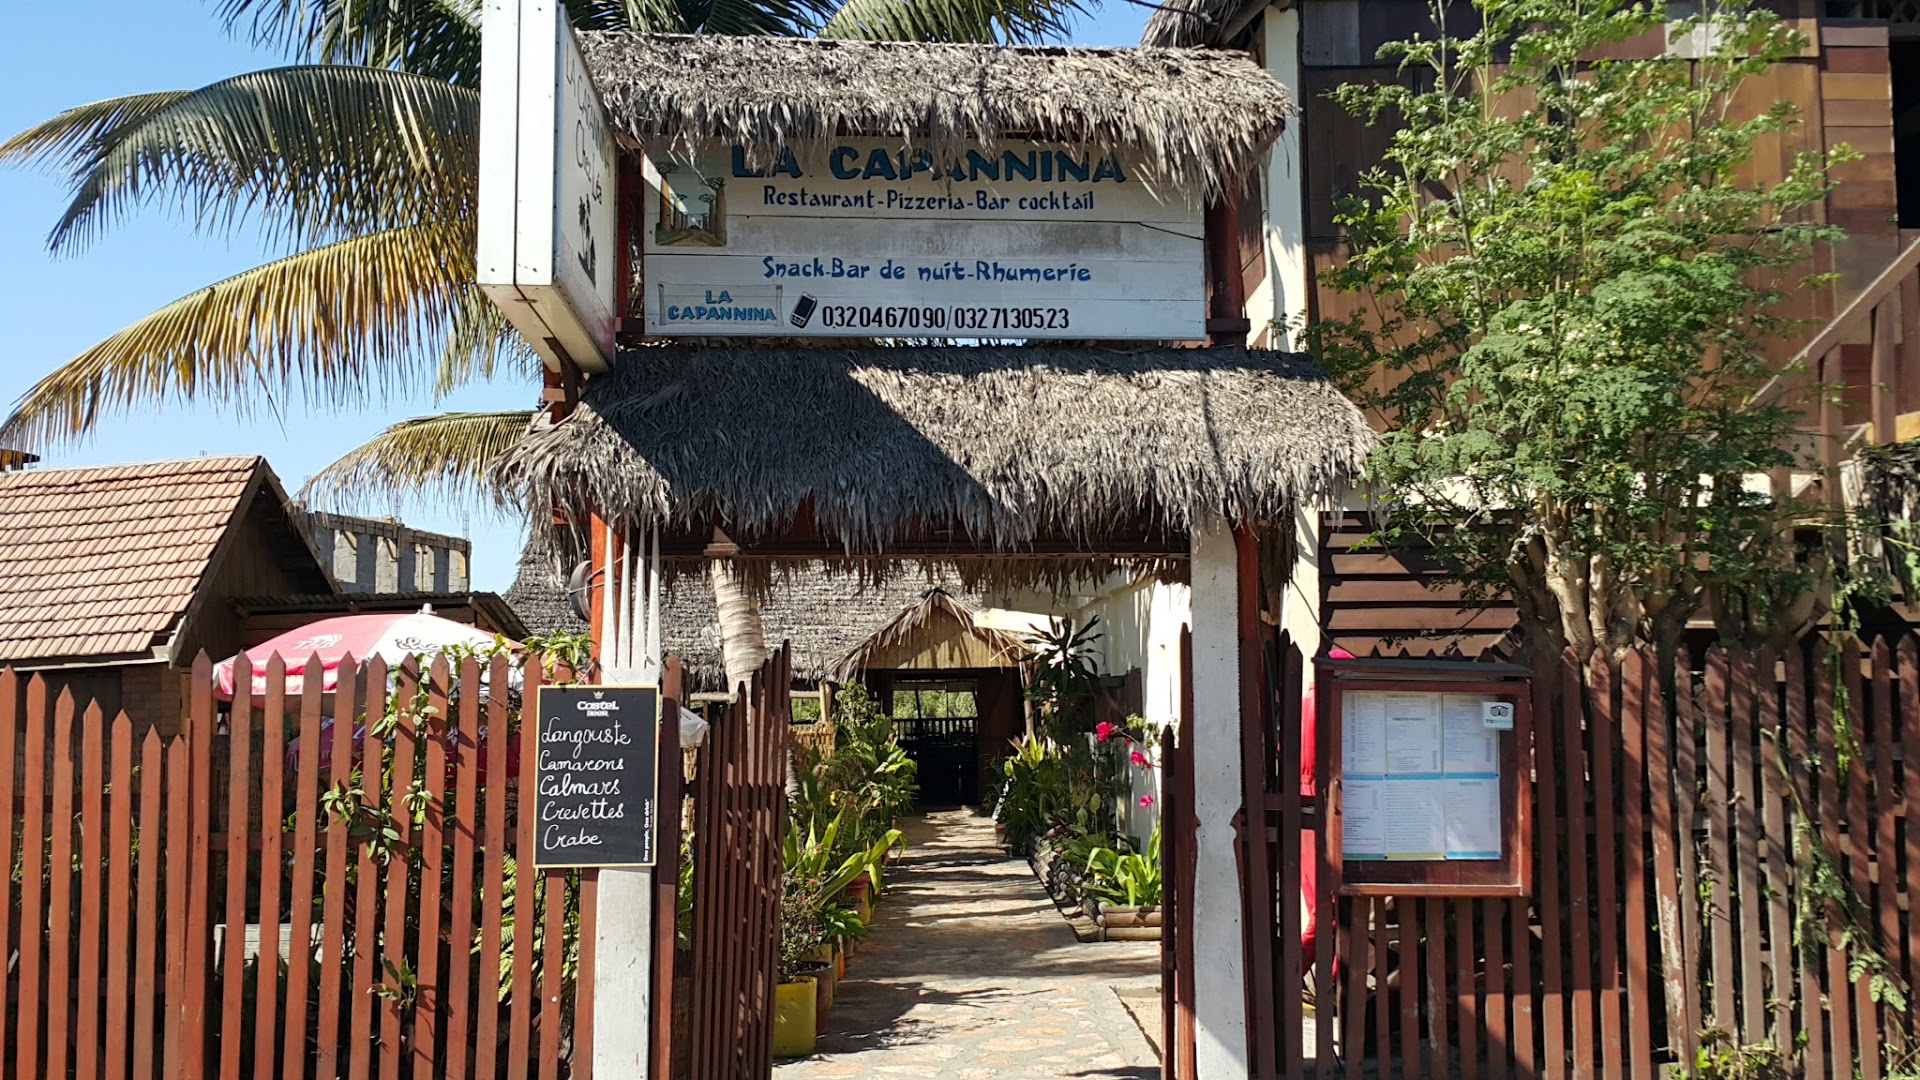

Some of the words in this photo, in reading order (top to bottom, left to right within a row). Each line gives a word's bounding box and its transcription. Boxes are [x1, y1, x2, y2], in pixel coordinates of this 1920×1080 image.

[731, 144, 803, 179] LA
[763, 185, 1011, 211] Restaurant-Pizzeria-Bar
[1018, 190, 1094, 210] cocktail
[763, 256, 870, 279] Snack-Bar
[880, 260, 905, 280] de
[917, 260, 1091, 283] nuit-Rhumerie
[705, 289, 733, 304] LA
[667, 305, 777, 321] CAPANNINA
[541, 716, 631, 759] Langouste
[539, 773, 620, 797] Calmars
[541, 798, 624, 821] Crevettes
[543, 824, 602, 850] Crabe
